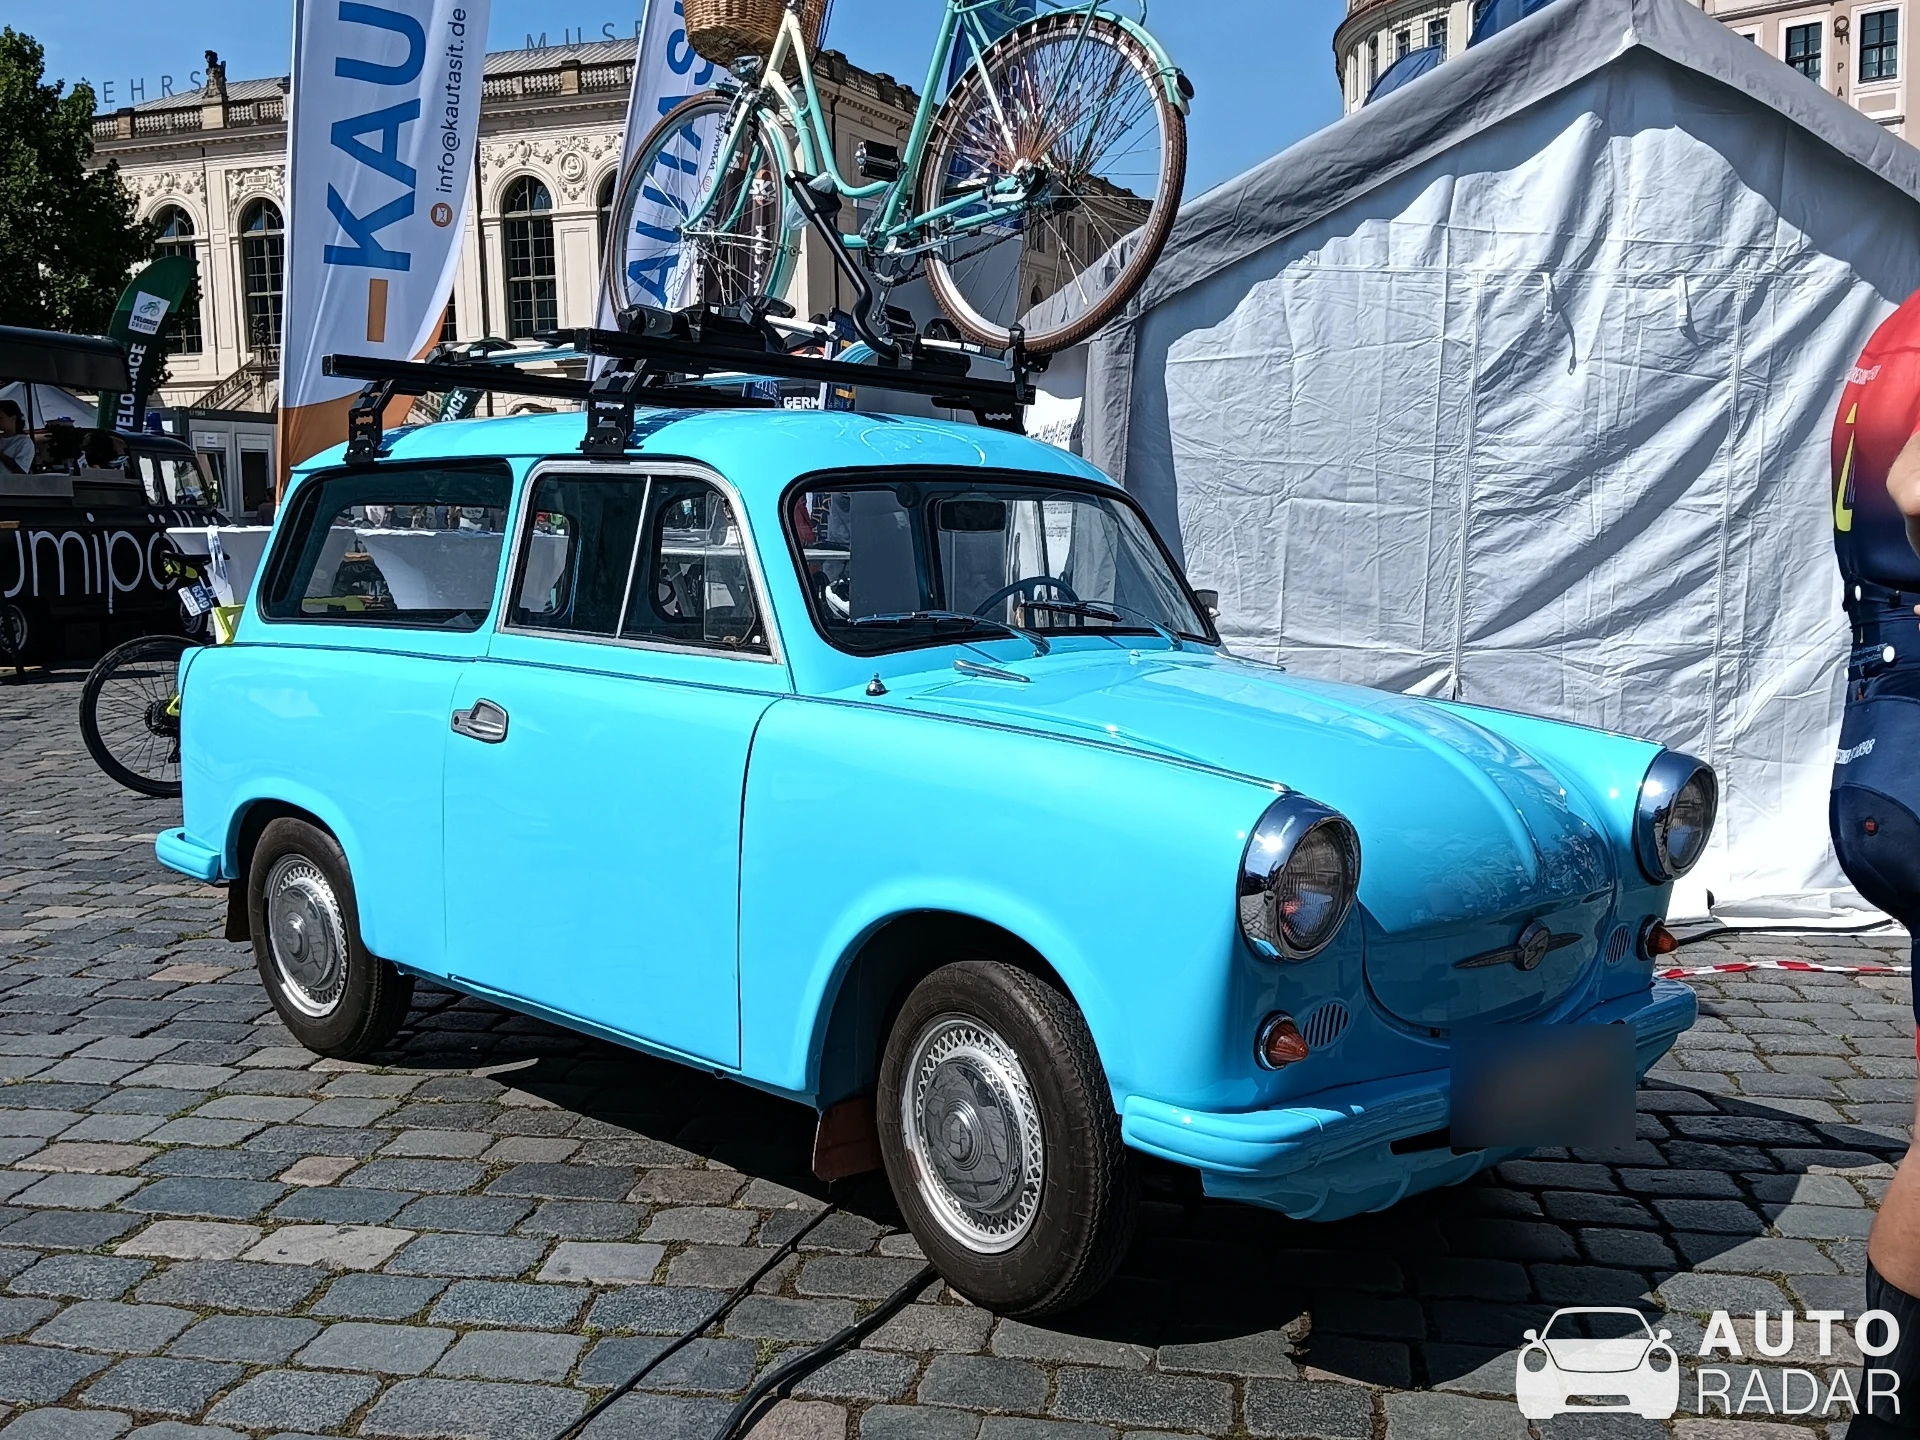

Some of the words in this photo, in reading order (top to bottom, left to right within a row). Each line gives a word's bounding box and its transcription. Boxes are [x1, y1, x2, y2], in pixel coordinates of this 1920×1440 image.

[103, 70, 202, 104] EHRS
[323, 1, 427, 272] KAU
[435, 7, 467, 193] info@kautasit.de
[115, 342, 148, 433] VELOACE
